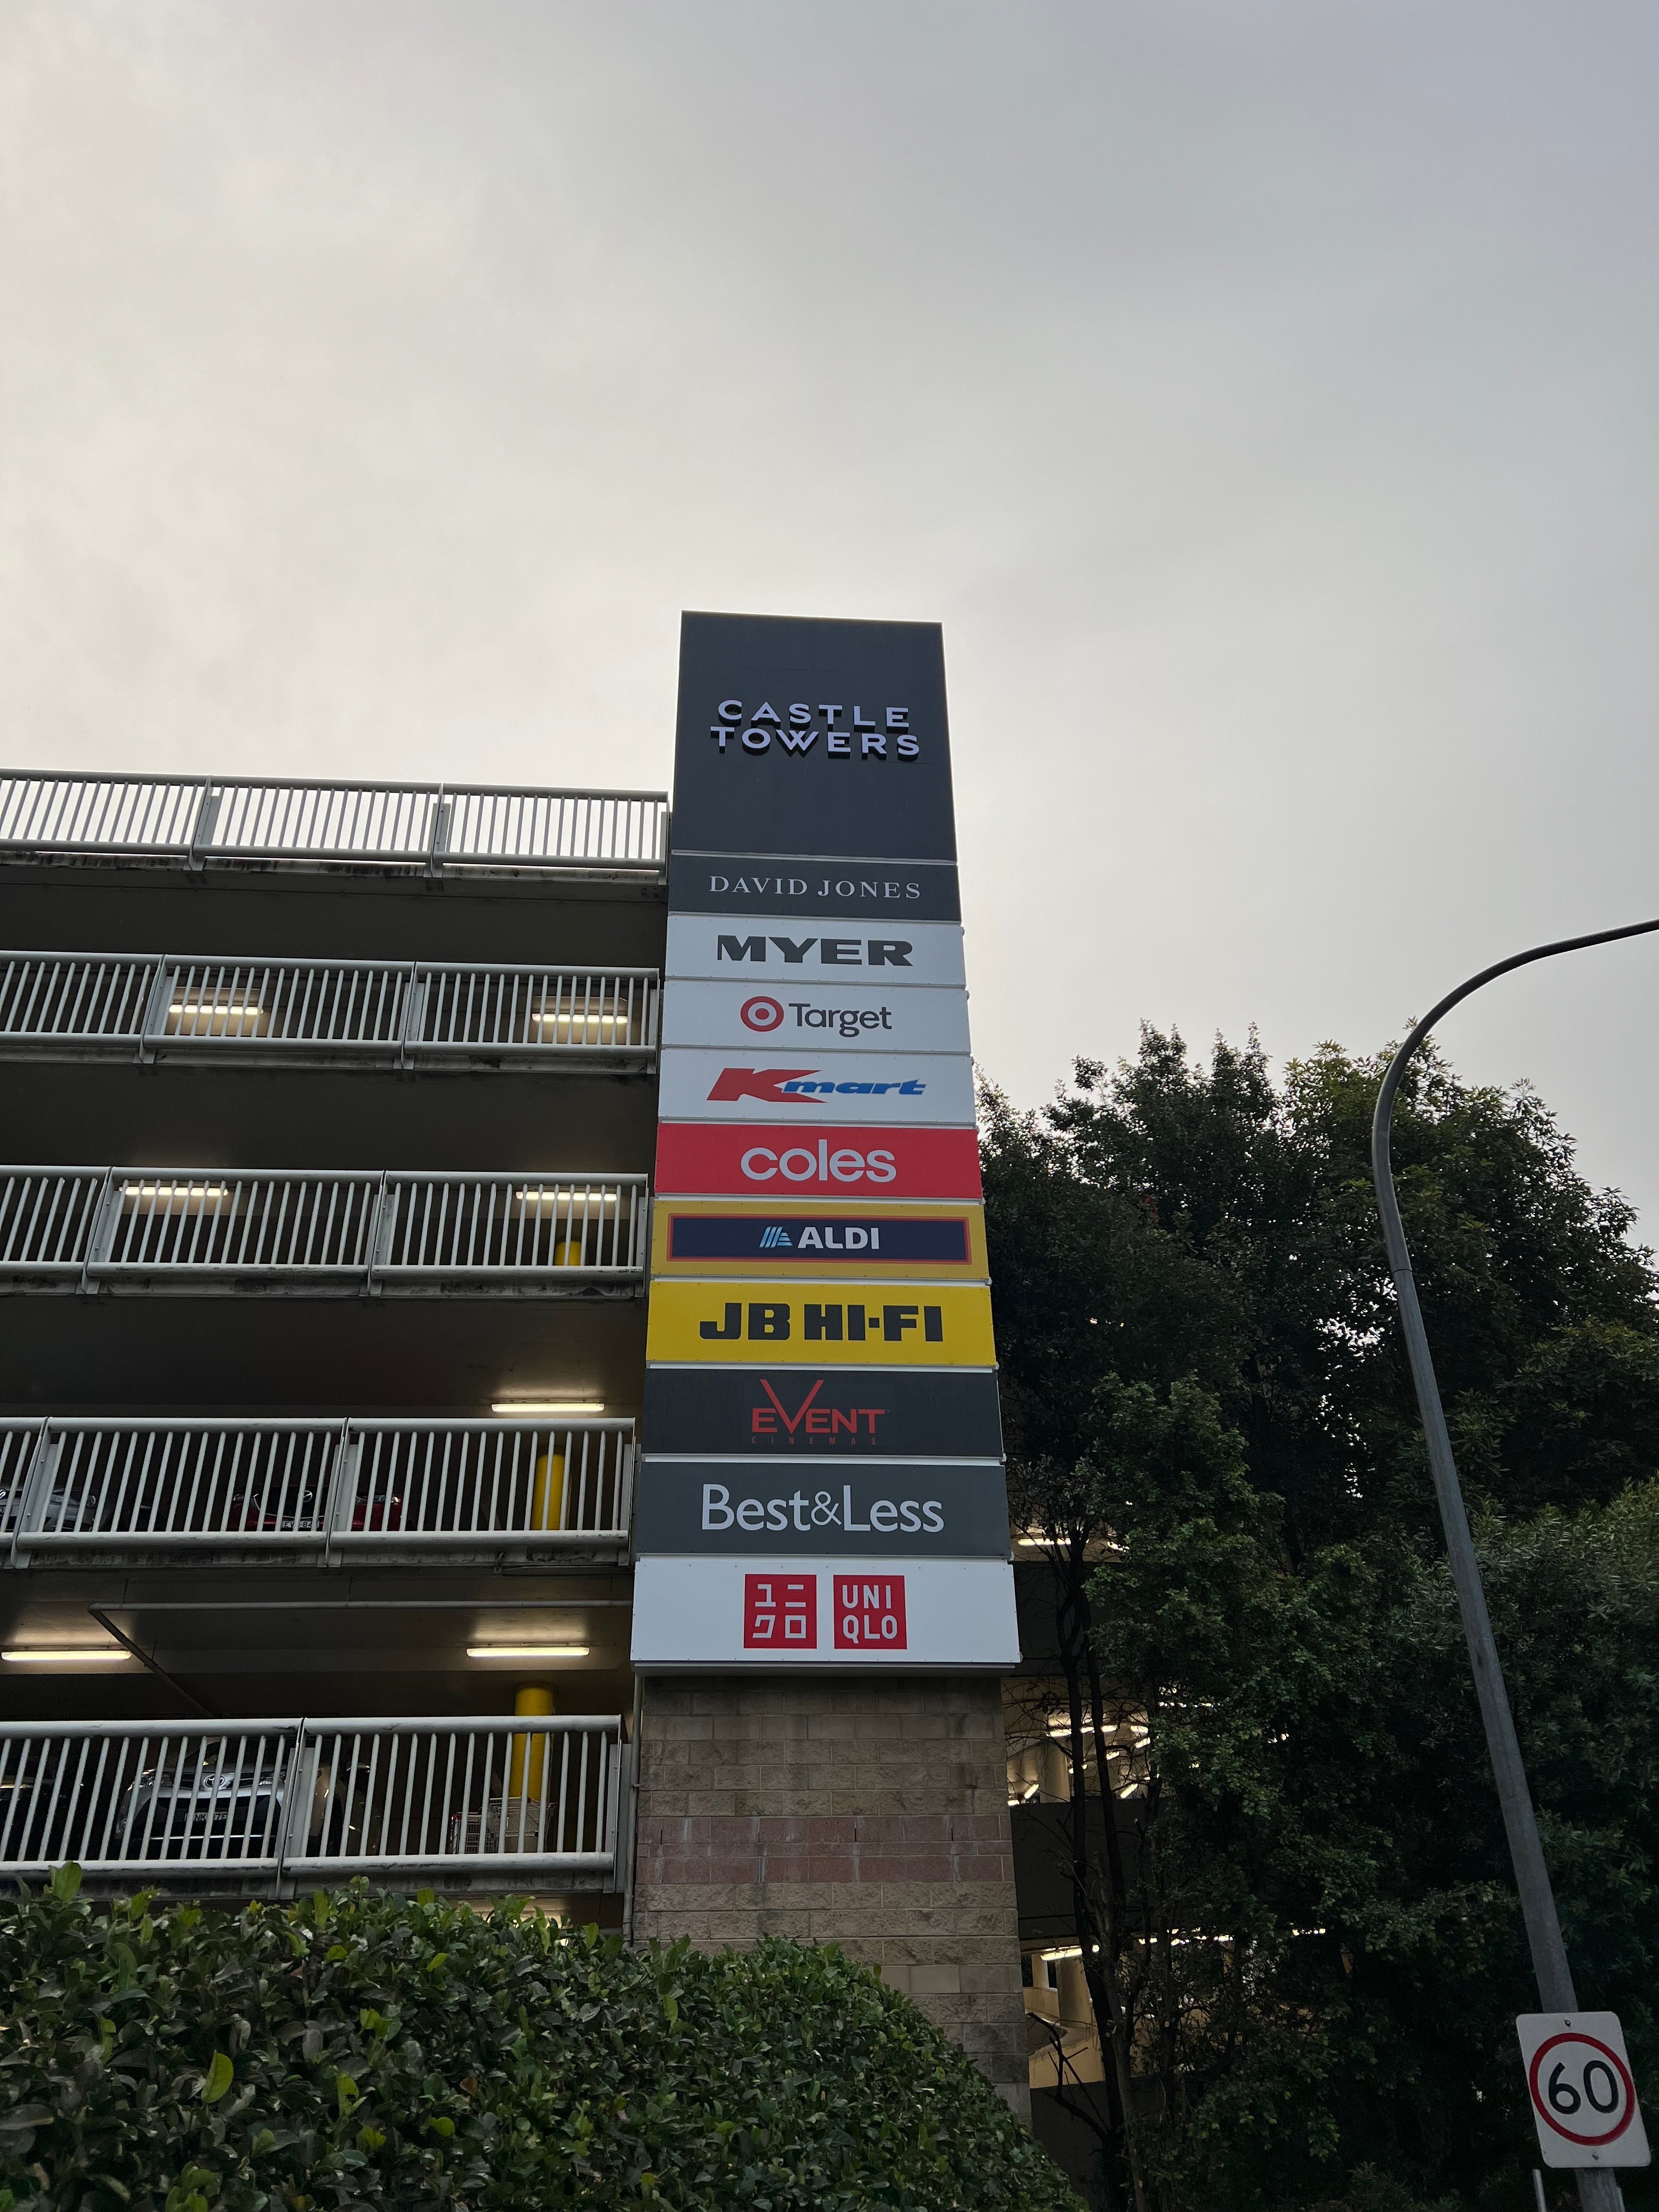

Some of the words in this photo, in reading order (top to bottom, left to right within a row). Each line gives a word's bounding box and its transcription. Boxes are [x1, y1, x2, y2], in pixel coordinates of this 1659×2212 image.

[718, 699, 910, 729] CASTLE
[710, 726, 920, 758] TOWERS
[709, 876, 808, 896] DAVID
[817, 880, 921, 899] JONES
[717, 935, 913, 966] MYER
[788, 1003, 892, 1037] Target
[706, 1068, 927, 1103] Kmart
[741, 1139, 897, 1182] coles
[798, 1227, 880, 1250] ALDI
[699, 1302, 791, 1340] JB
[804, 1304, 944, 1342] HI-FI
[752, 1379, 885, 1434] EVENT
[752, 1436, 876, 1446] CINEMAS
[701, 1483, 945, 1533] Best&Less
[842, 1584, 891, 1609] UNI
[843, 1615, 898, 1644] QLO
[1548, 2060, 1620, 2114] 60
